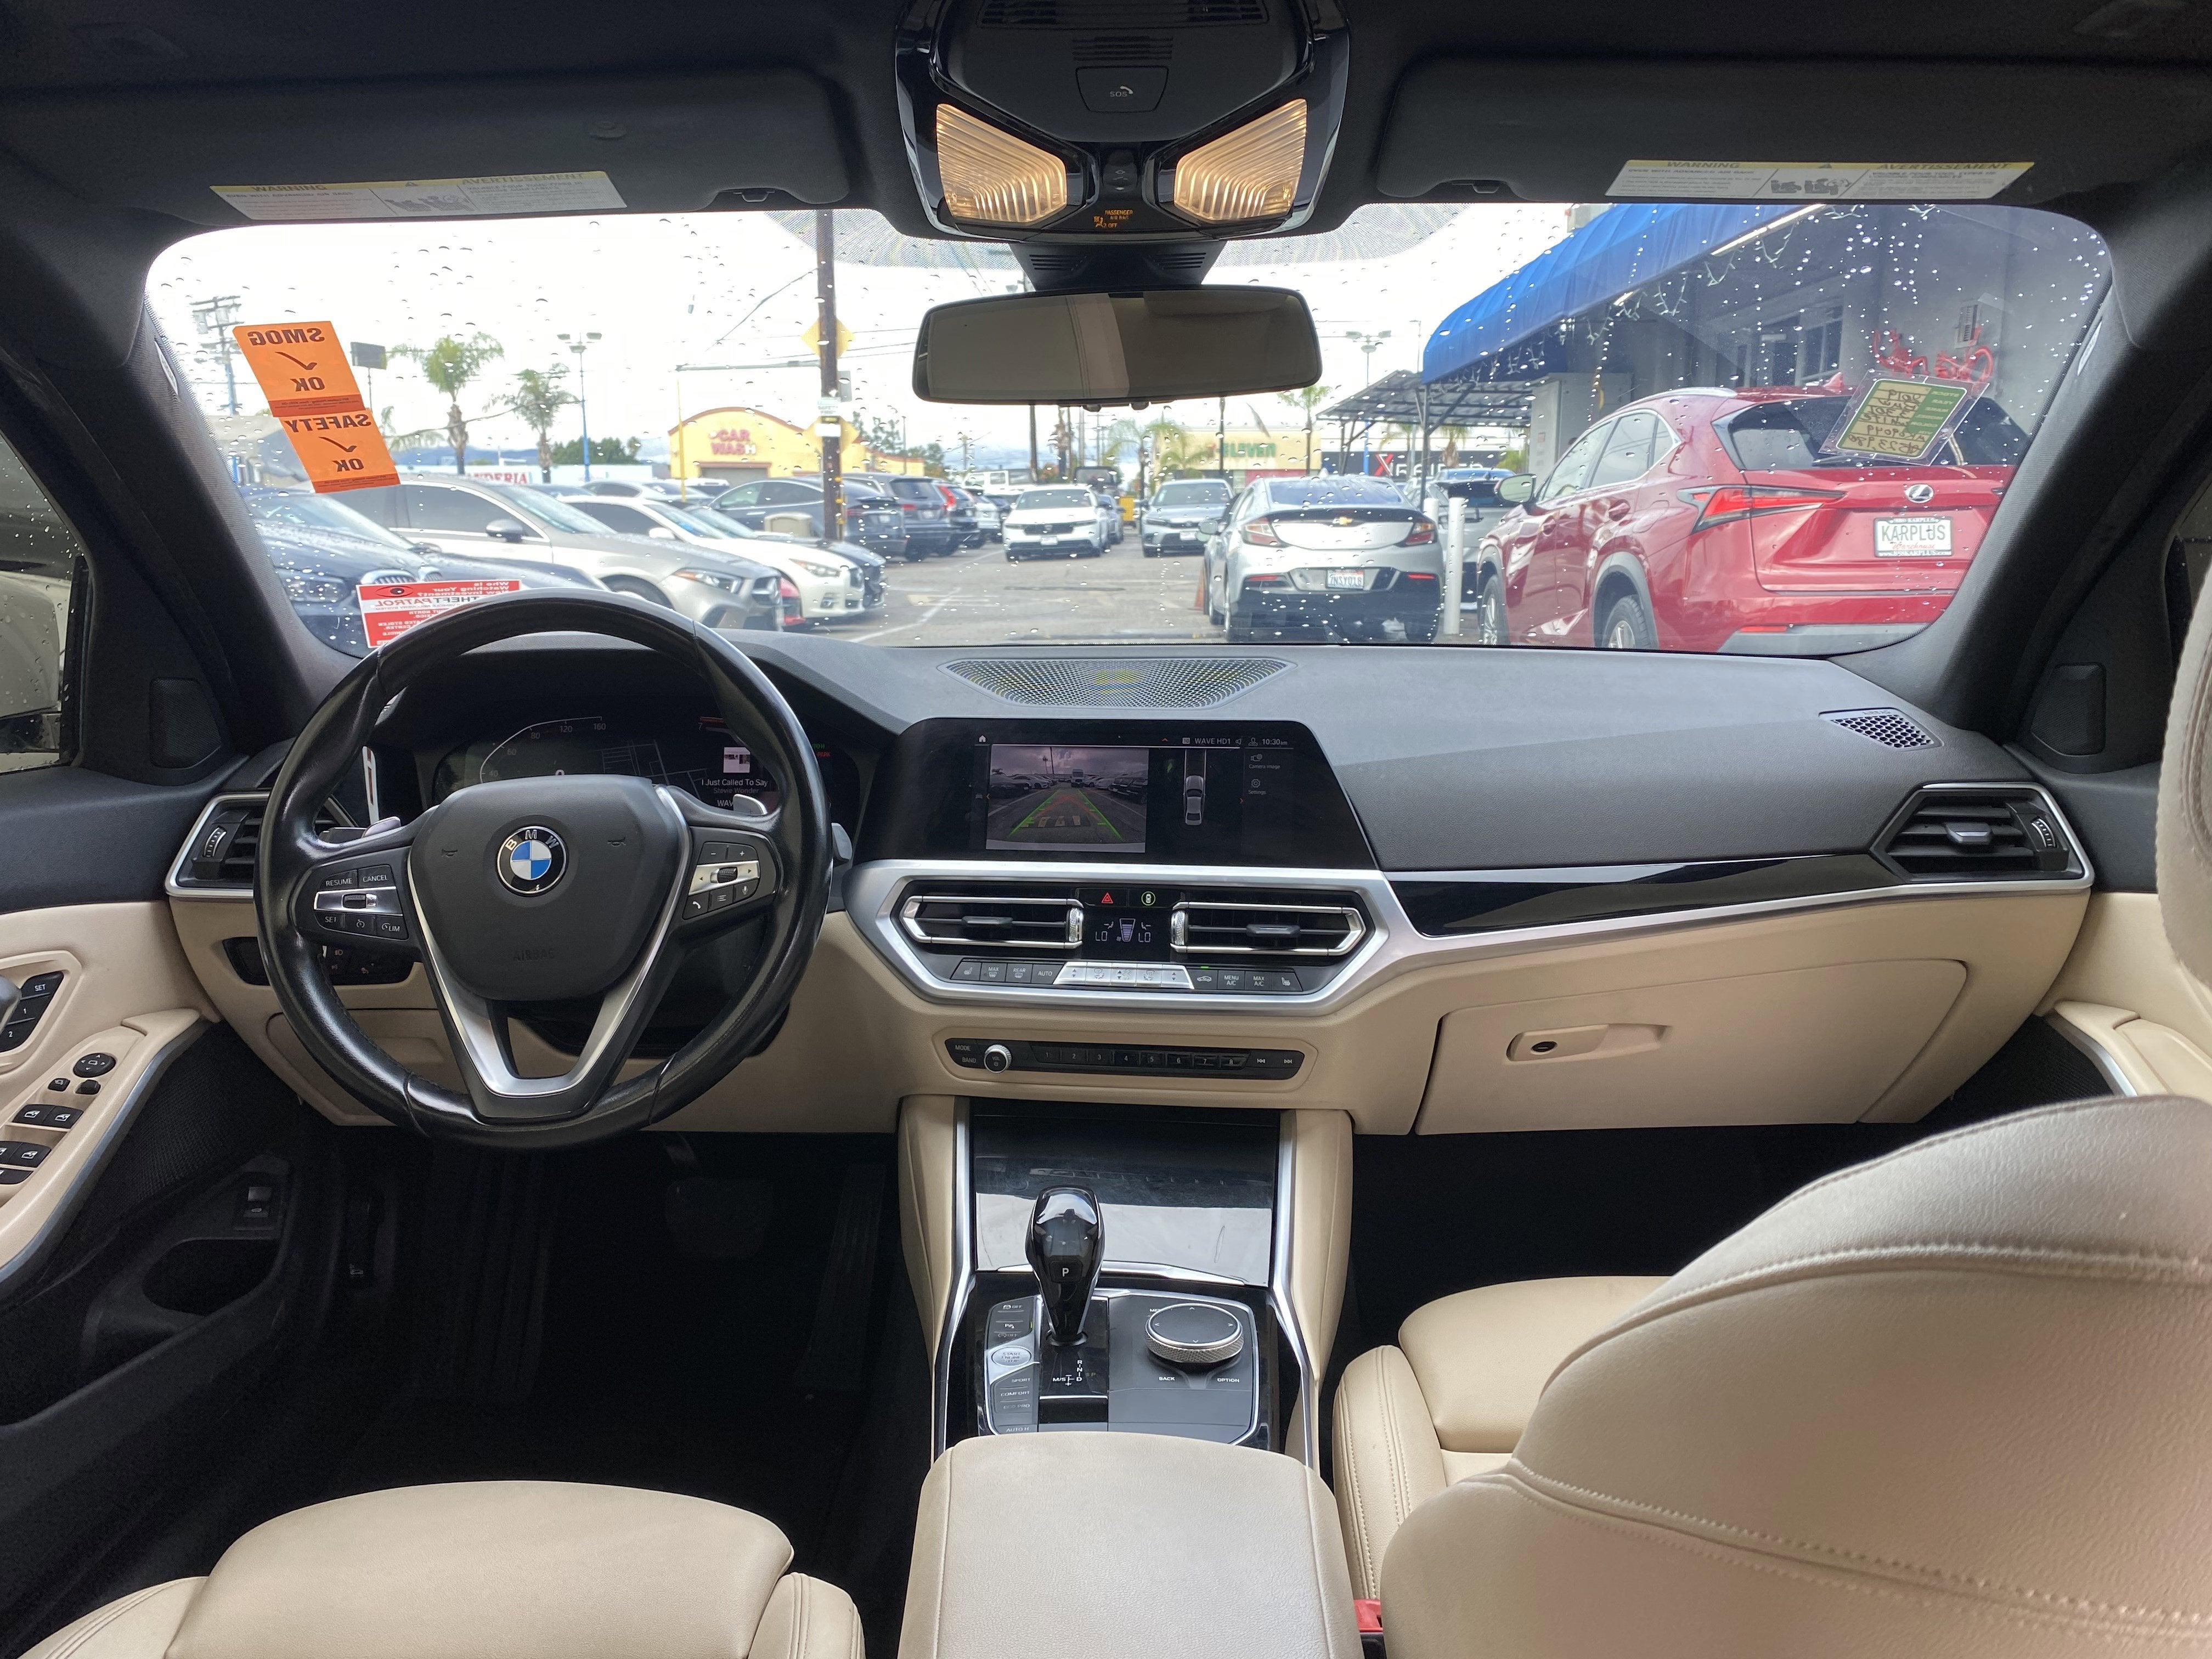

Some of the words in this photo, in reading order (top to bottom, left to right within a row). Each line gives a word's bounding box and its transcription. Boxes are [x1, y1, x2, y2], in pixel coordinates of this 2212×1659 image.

[462, 173, 585, 185] AVERTISSEMENT
[716, 428, 751, 441] CAR
[710, 442, 757, 455] WASH
[1881, 524, 1946, 541] KARPLUS
[593, 723, 606, 731] 160
[698, 723, 703, 731] 7
[755, 779, 768, 787] Say
[505, 829, 560, 851] BMW
[325, 878, 353, 887] RESUME
[363, 874, 387, 883] CANCEL
[1094, 931, 1108, 941] LO
[1138, 932, 1151, 943] LO
[35, 984, 46, 992] SET
[1062, 1267, 1069, 1277] P
